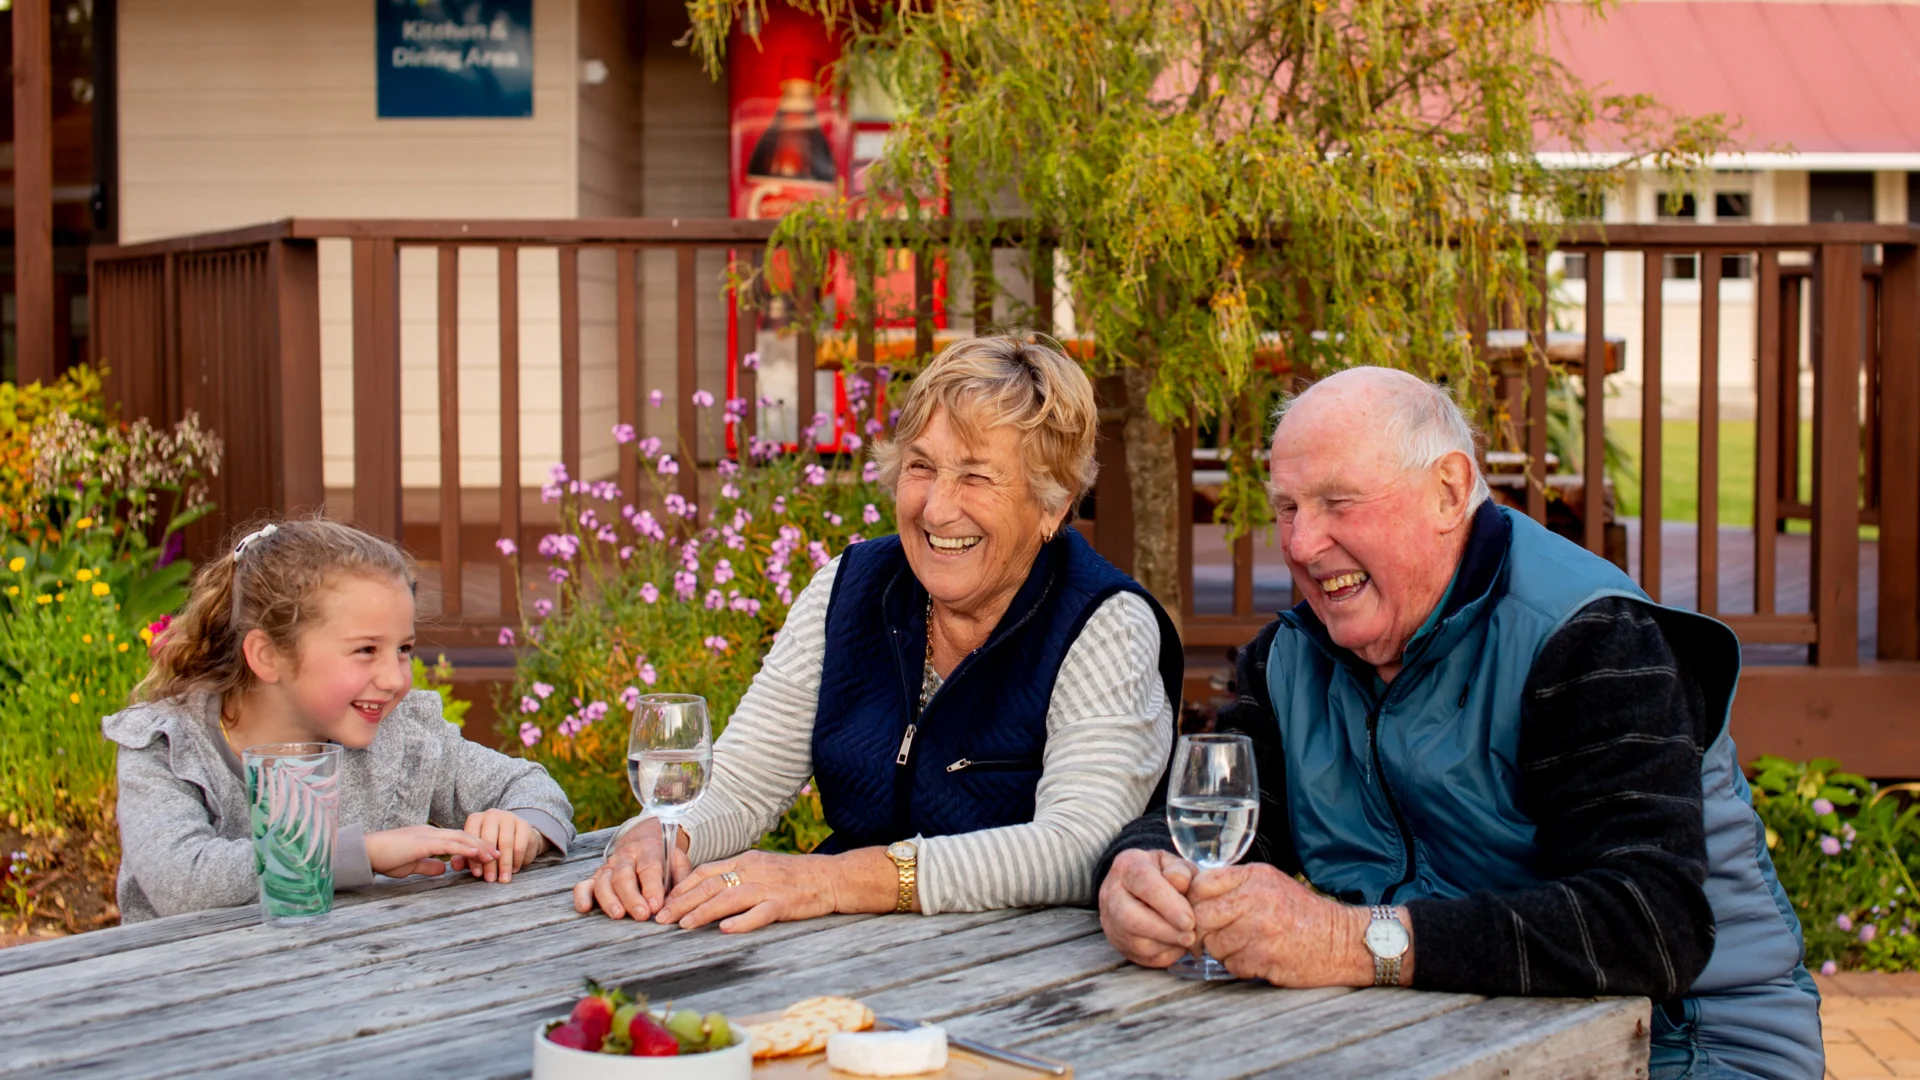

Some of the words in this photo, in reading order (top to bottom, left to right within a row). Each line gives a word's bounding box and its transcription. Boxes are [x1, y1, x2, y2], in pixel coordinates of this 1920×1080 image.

[402, 20, 487, 40] Kitchen
[490, 20, 508, 40] &
[392, 47, 462, 72] Dining
[465, 47, 519, 67] Area
